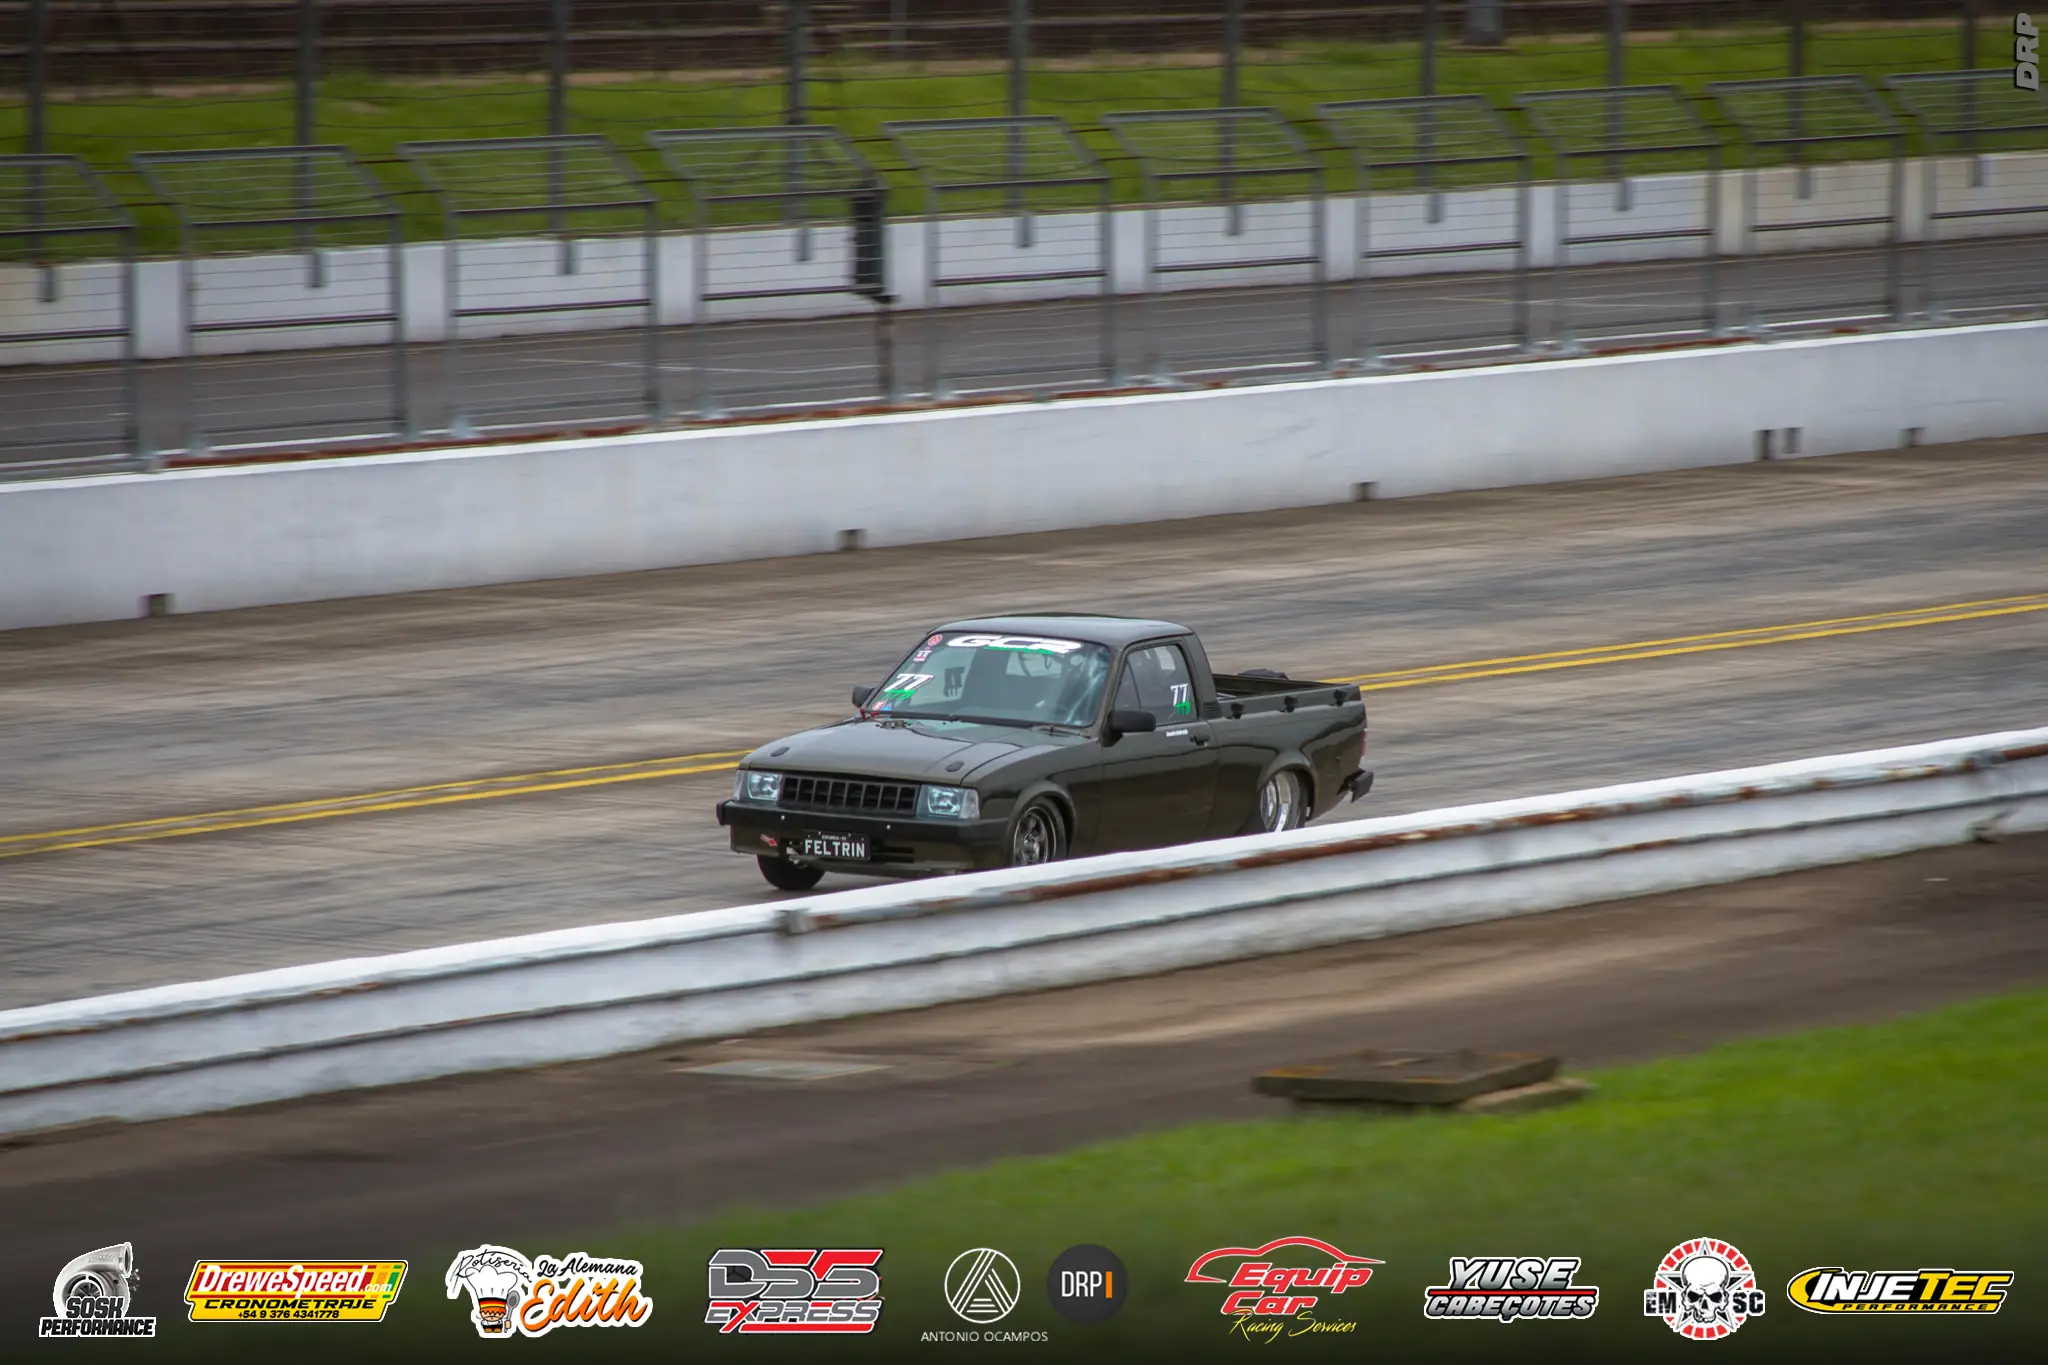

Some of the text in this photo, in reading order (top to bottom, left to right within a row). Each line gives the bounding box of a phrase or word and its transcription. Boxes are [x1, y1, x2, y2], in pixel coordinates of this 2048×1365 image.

[884, 673, 934, 692] 77
[1170, 683, 1188, 707] 77
[804, 839, 865, 858] FELTRIN
